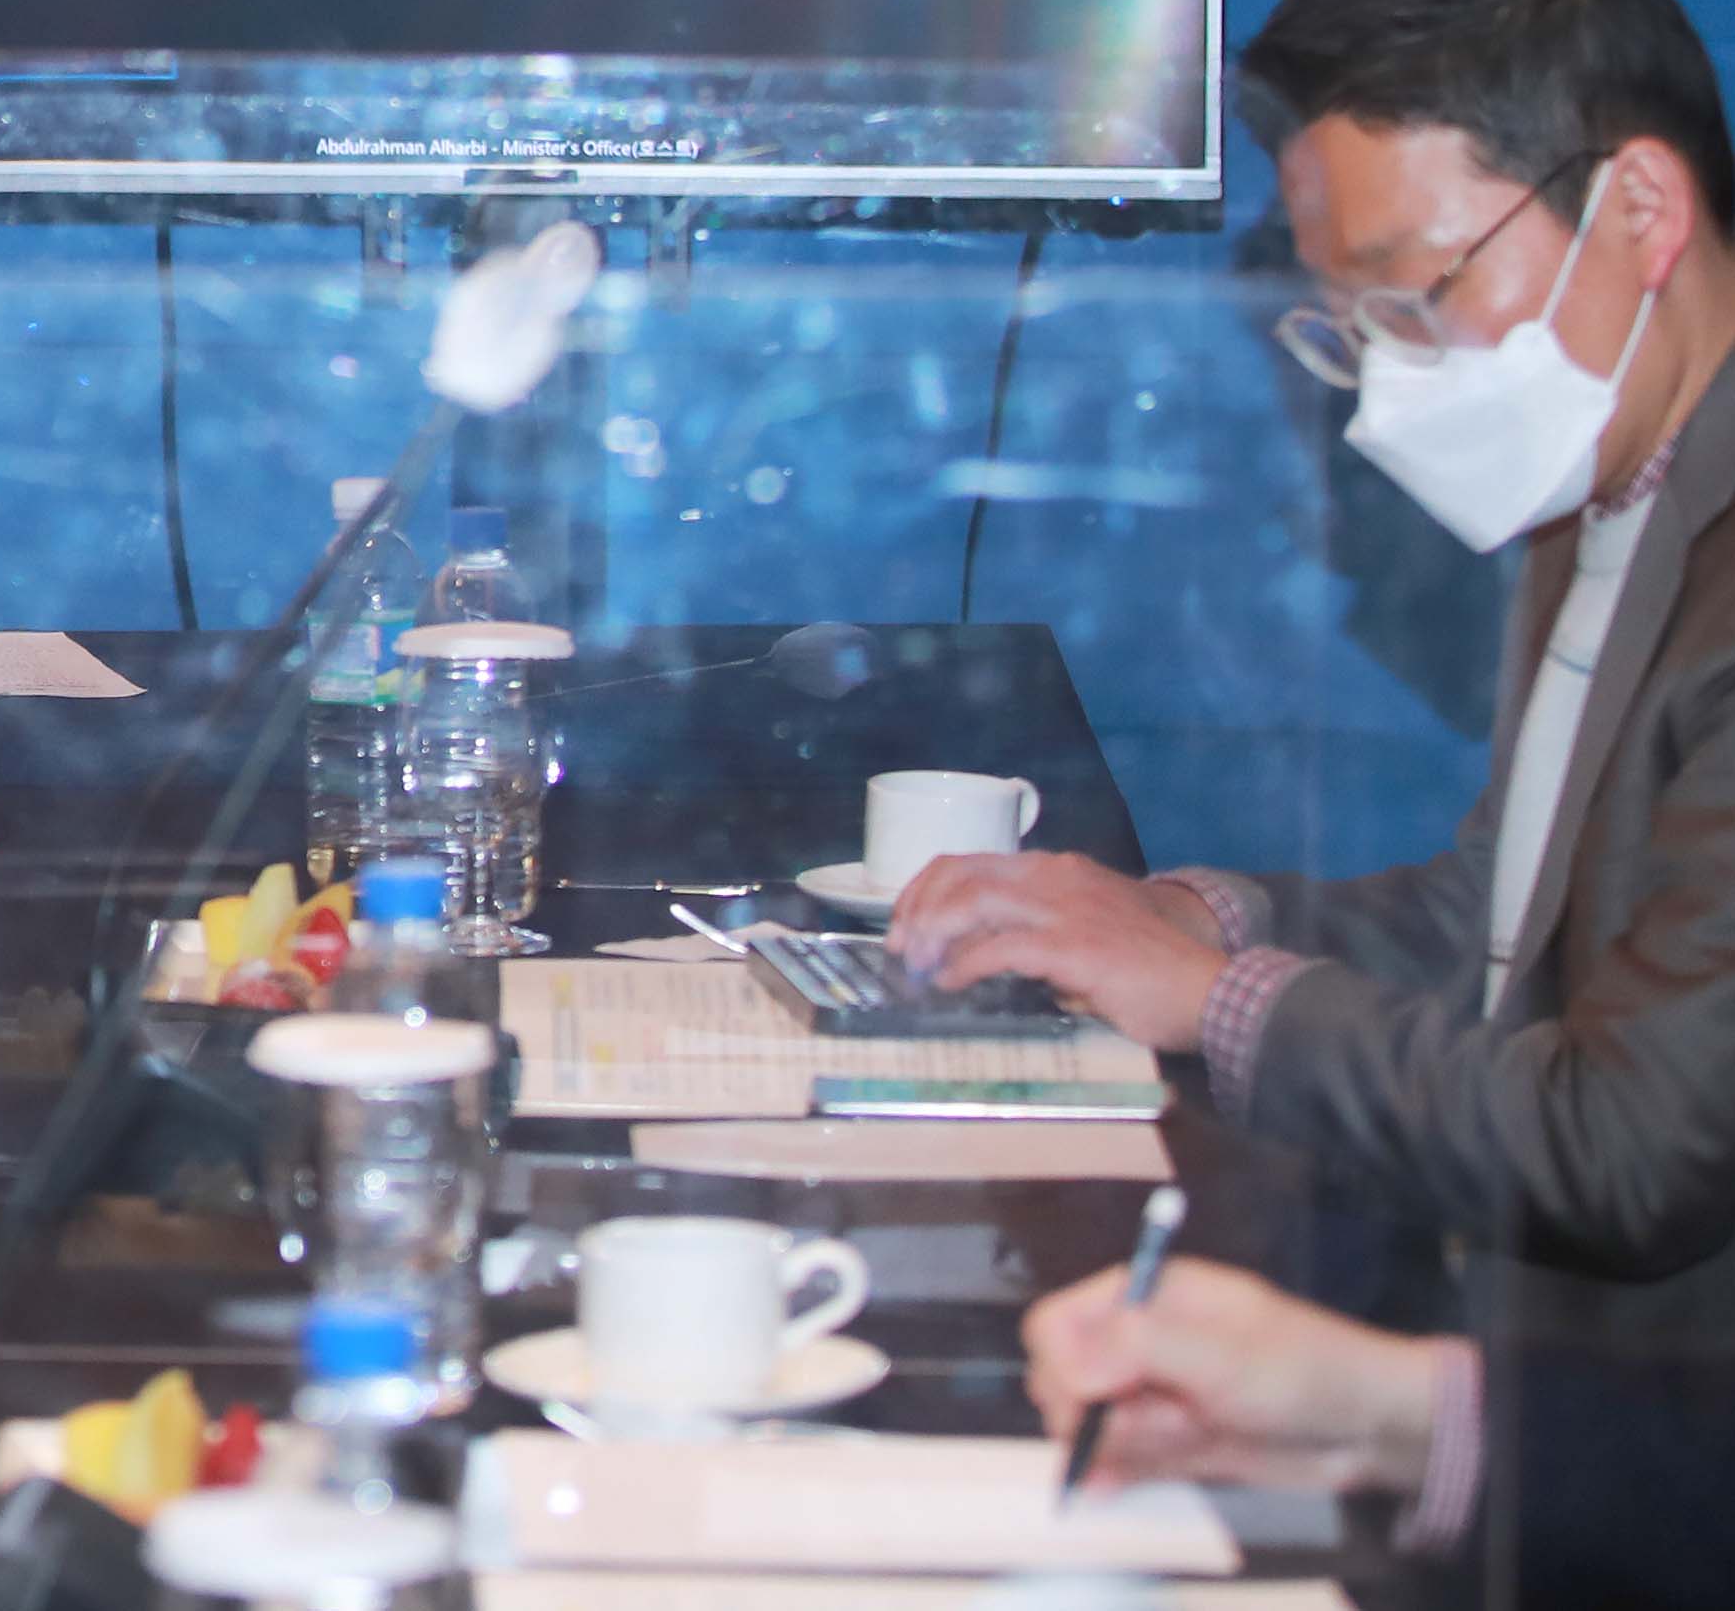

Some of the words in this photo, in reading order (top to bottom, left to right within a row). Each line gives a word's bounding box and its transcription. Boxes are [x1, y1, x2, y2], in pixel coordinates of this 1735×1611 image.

[315, 138, 426, 156] Abdulrahman
[429, 138, 488, 157] Alharbi
[502, 139, 581, 157] Minister's
